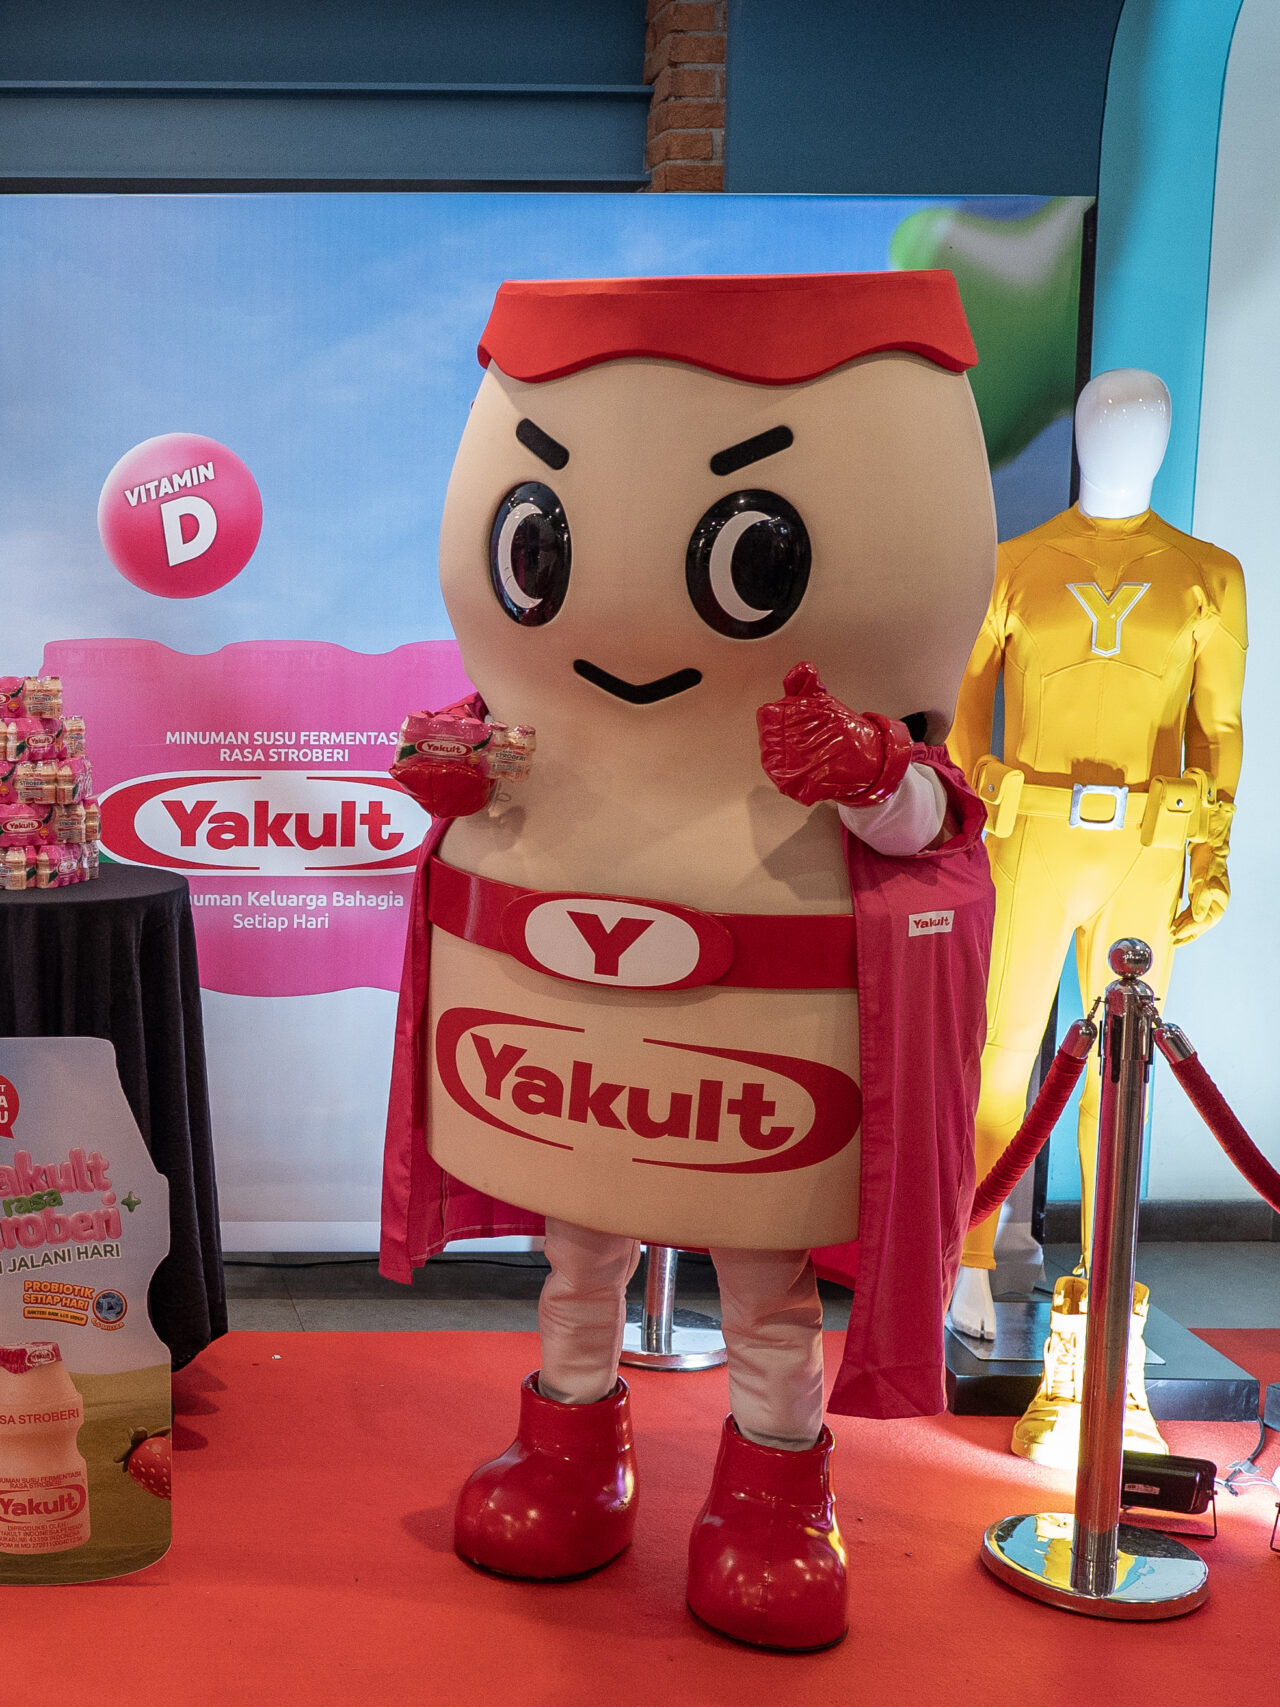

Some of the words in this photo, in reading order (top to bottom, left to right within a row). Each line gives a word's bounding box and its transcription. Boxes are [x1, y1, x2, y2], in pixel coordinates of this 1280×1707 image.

[125, 461, 216, 508] VITAMIN
[160, 495, 218, 568] D
[1065, 582, 1151, 657] Y
[166, 731, 249, 745] MINUMAN
[253, 731, 296, 745] SUSU
[300, 731, 402, 745] FERMENTAS
[220, 748, 265, 762] RASA
[269, 748, 349, 762] STROBERI
[426, 743, 462, 754] Yakult
[10, 822, 36, 830] Yakult
[161, 800, 404, 850] Yakult
[248, 890, 327, 910] Keluarga
[333, 890, 404, 910] Bahagia
[233, 913, 288, 932] Setiap
[294, 913, 329, 929] Hari
[913, 916, 950, 928] Yakult
[566, 910, 655, 977] Y
[470, 1032, 795, 1151] Yakult
[3, 1188, 64, 1217] rasa
[8, 1248, 71, 1273] JALANI
[77, 1243, 120, 1261] HARI
[24, 1280, 95, 1299] PROBIOTIK
[23, 1293, 60, 1306] SETIAP
[61, 1297, 89, 1311] HARI
[18, 1408, 80, 1425] STROBERI
